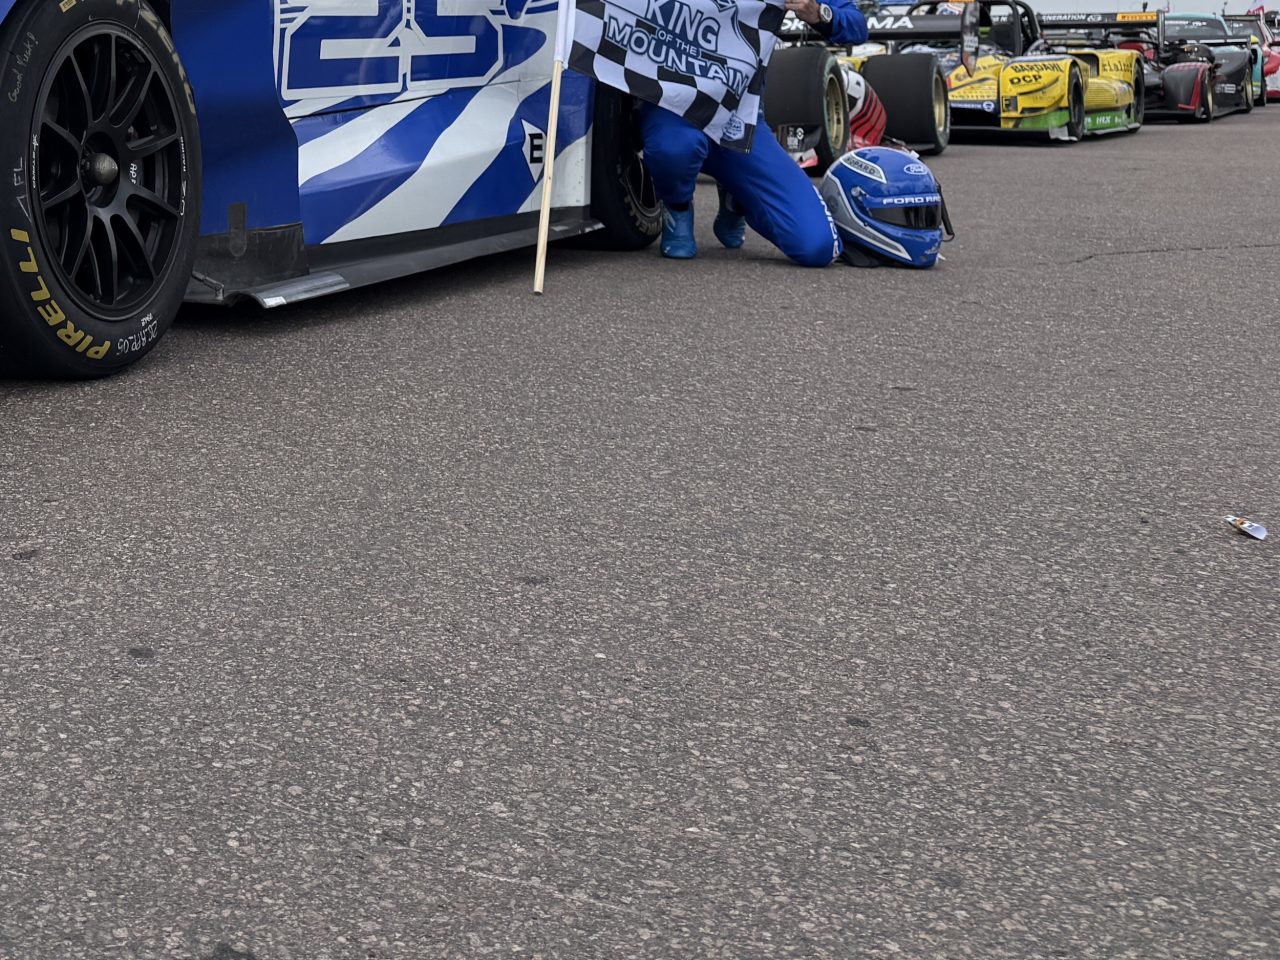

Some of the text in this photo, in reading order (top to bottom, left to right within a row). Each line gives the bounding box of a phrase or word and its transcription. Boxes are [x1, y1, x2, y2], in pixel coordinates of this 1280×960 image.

[608, 16, 749, 98] MOUNTAIN
[657, 30, 698, 56] OF THE
[1011, 62, 1064, 74] BARDAHL
[8, 67, 24, 103] Good
[529, 132, 545, 163] E
[883, 197, 924, 205] FORD
[10, 228, 111, 360] PIRELLI
